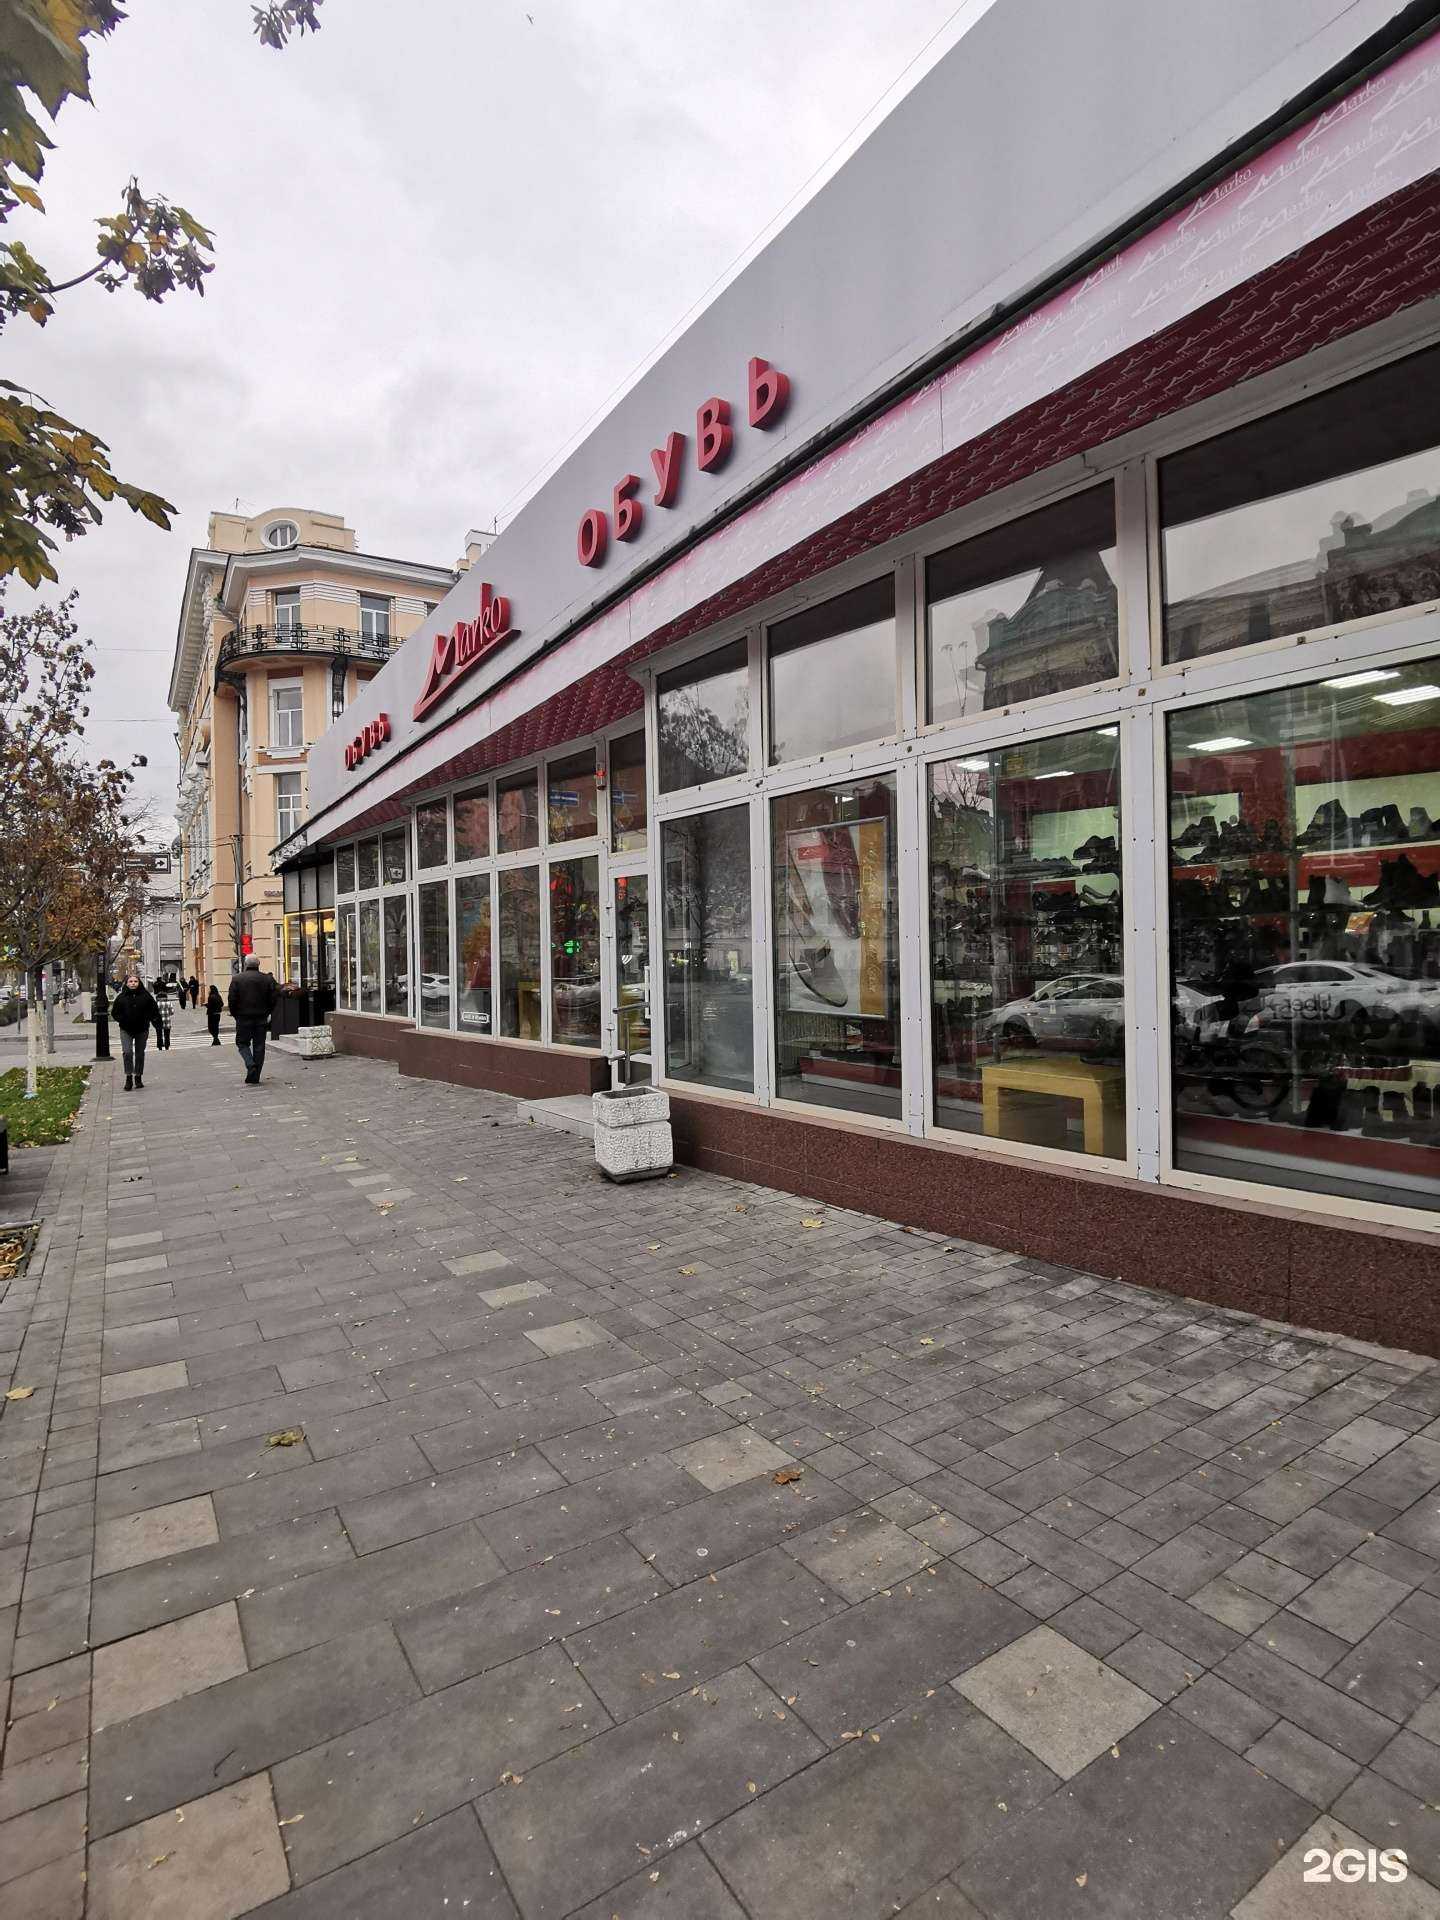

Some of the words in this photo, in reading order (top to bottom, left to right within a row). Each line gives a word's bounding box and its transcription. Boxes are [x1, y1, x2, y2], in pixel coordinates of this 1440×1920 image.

[1177, 168, 1257, 231] Marko
[577, 356, 791, 567] ОБУВЬ
[413, 582, 520, 722] Marko
[344, 712, 391, 771] ОБУВЬ
